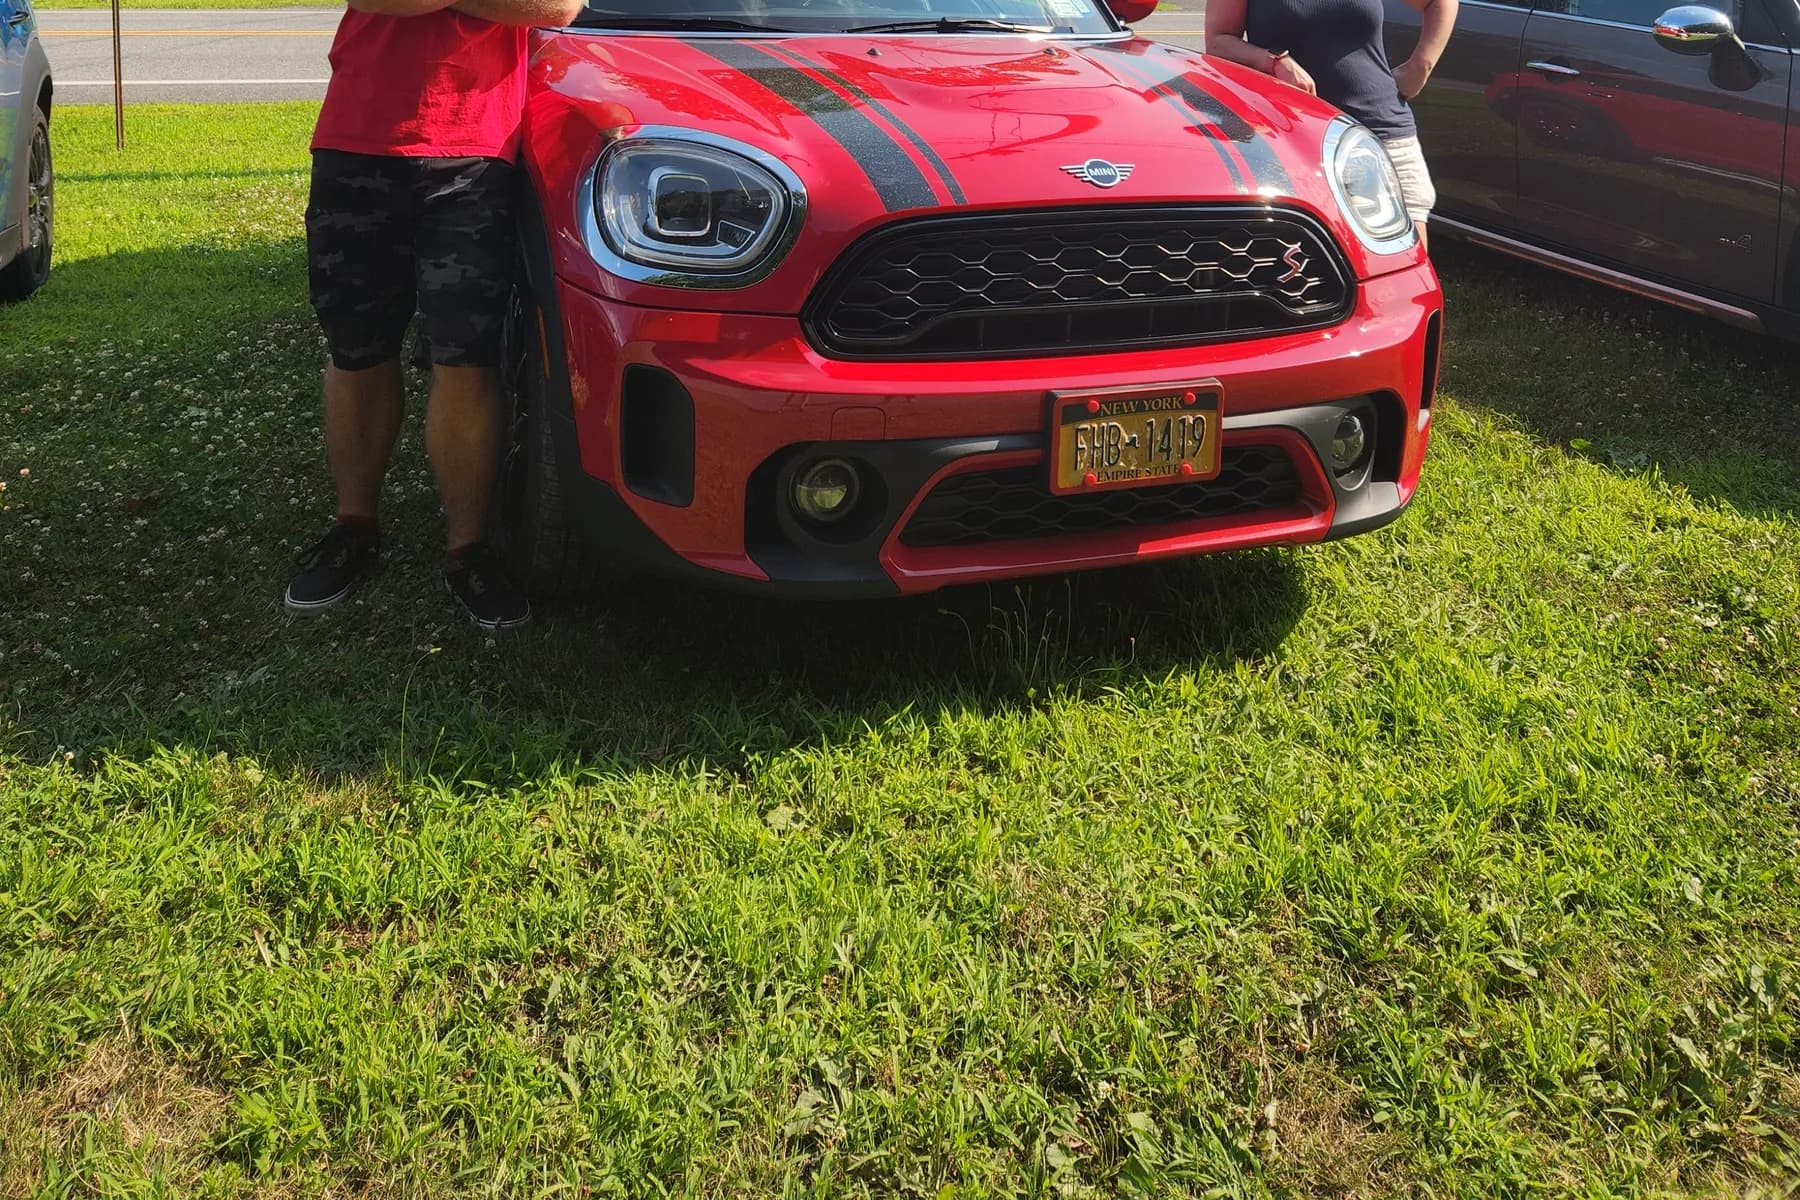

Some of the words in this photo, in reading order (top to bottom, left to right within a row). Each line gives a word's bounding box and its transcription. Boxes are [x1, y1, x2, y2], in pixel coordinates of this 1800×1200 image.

[1088, 167, 1116, 177] MINI
[1101, 401, 1138, 416] NEW
[1143, 397, 1182, 411] YORK
[1074, 421, 1122, 471] FHB
[1146, 414, 1207, 463] 1419
[1097, 468, 1140, 482] EMPIRE
[1145, 464, 1179, 478] STATE
